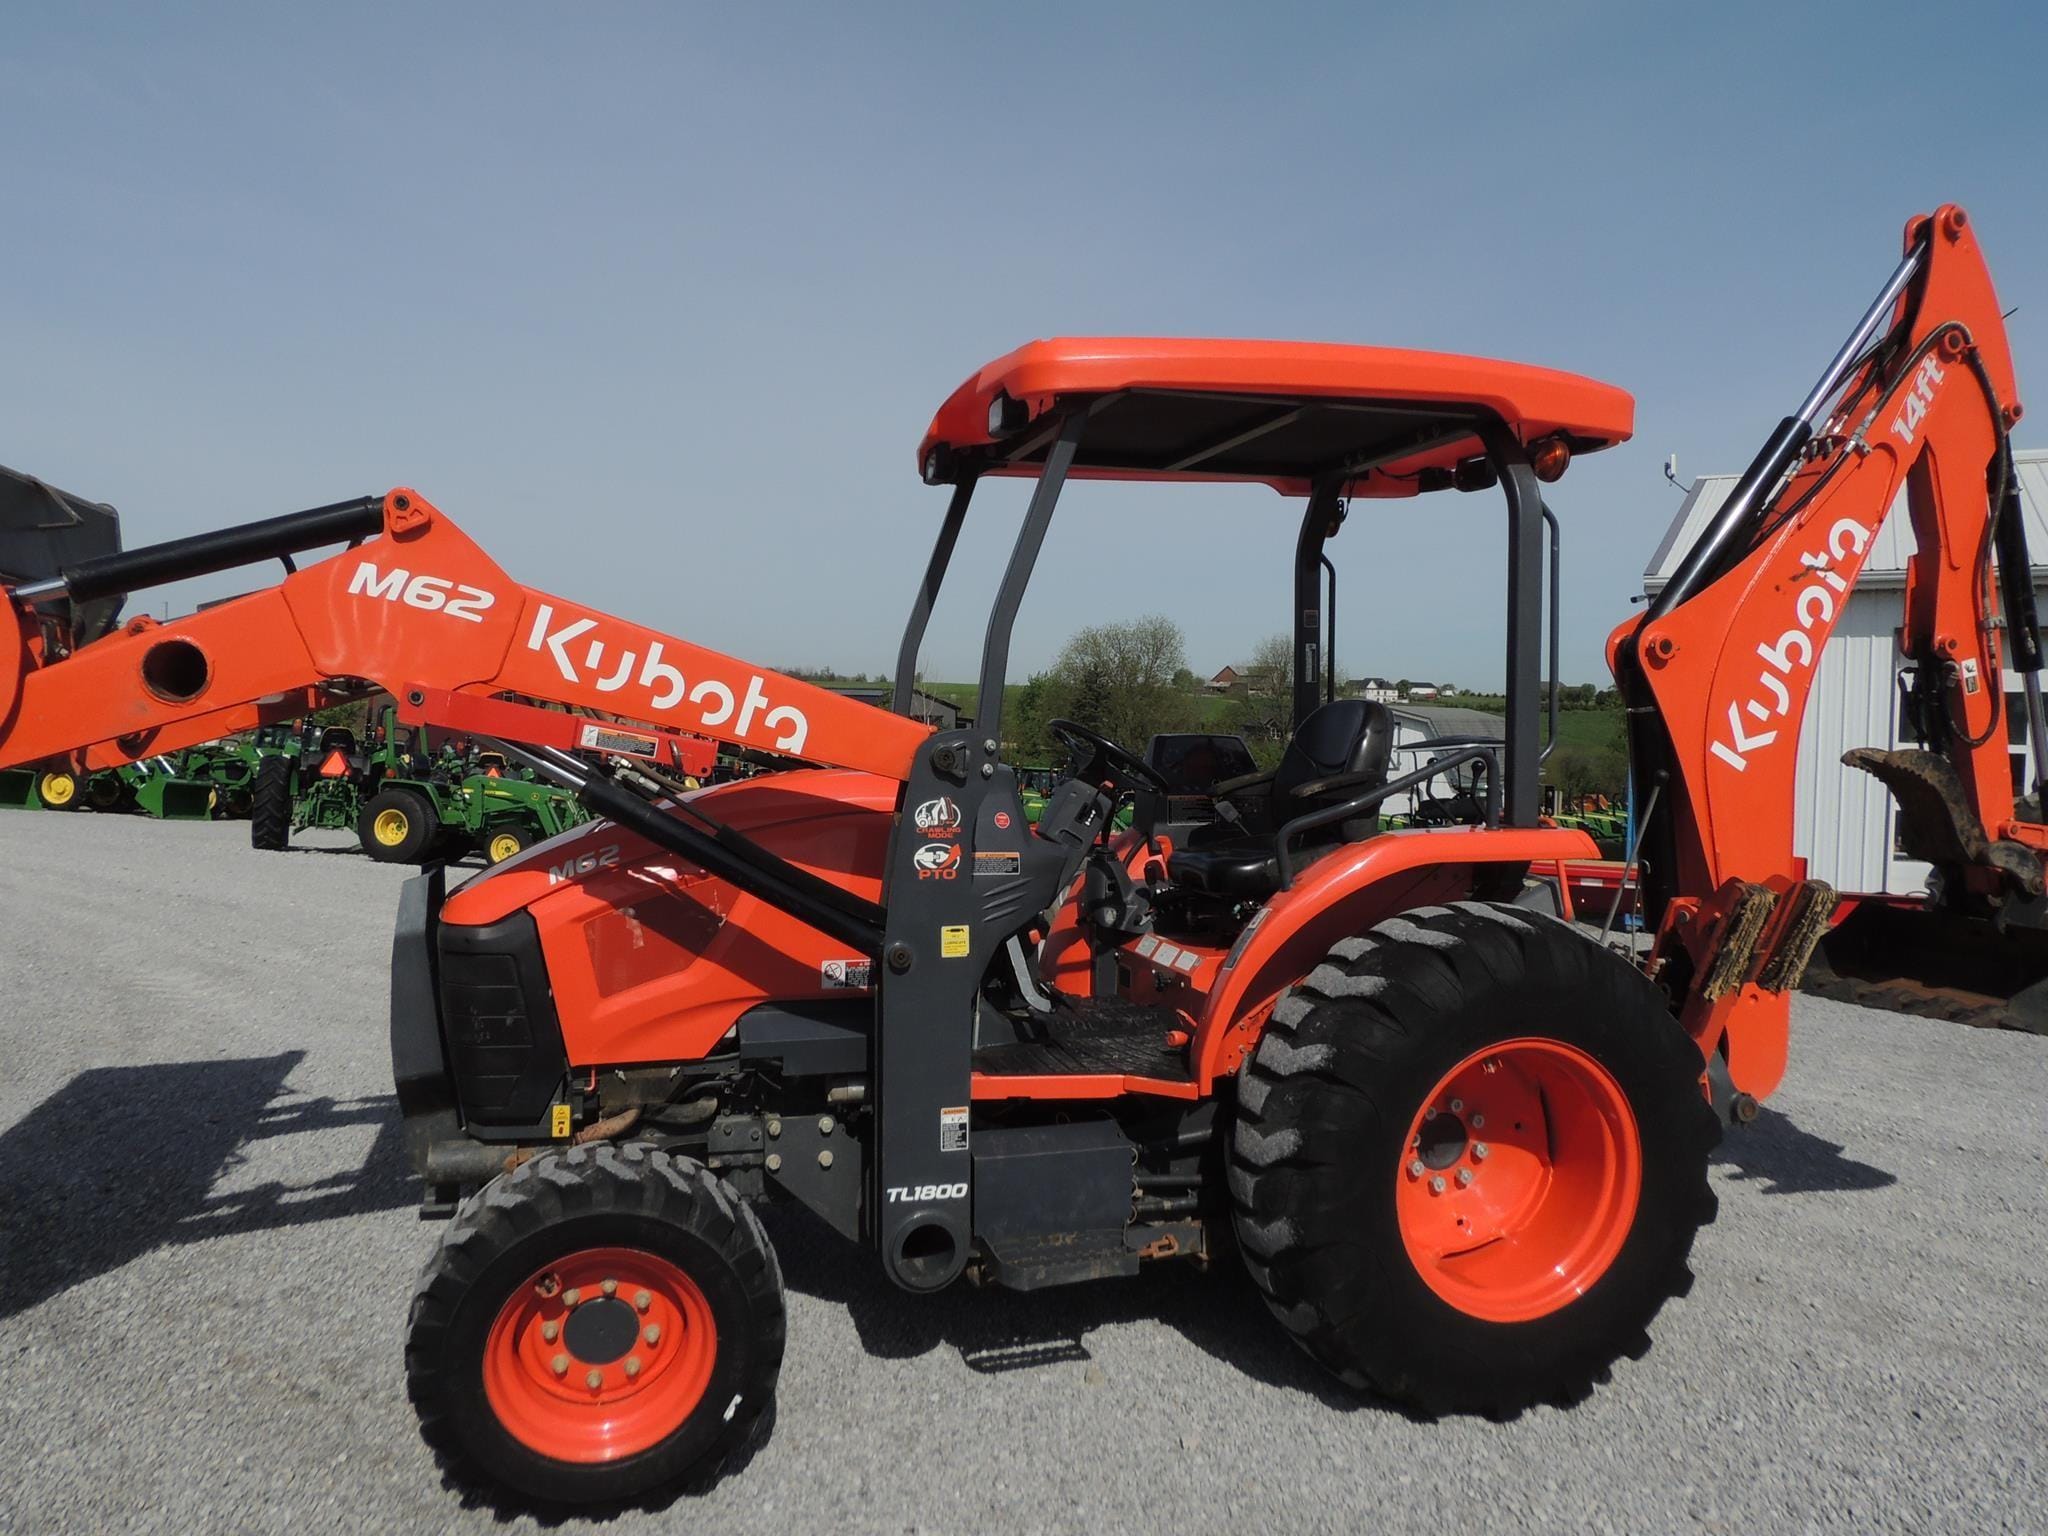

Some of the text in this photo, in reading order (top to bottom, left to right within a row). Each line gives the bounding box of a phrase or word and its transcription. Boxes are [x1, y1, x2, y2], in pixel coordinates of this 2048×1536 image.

[1893, 355, 1945, 445] 14ft
[347, 562, 495, 623] M62
[1709, 518, 1870, 772] Kubota
[527, 603, 808, 755] Kubota
[548, 845, 620, 885] M62
[919, 869, 957, 880] PTO
[886, 1183, 969, 1203] TL1800
